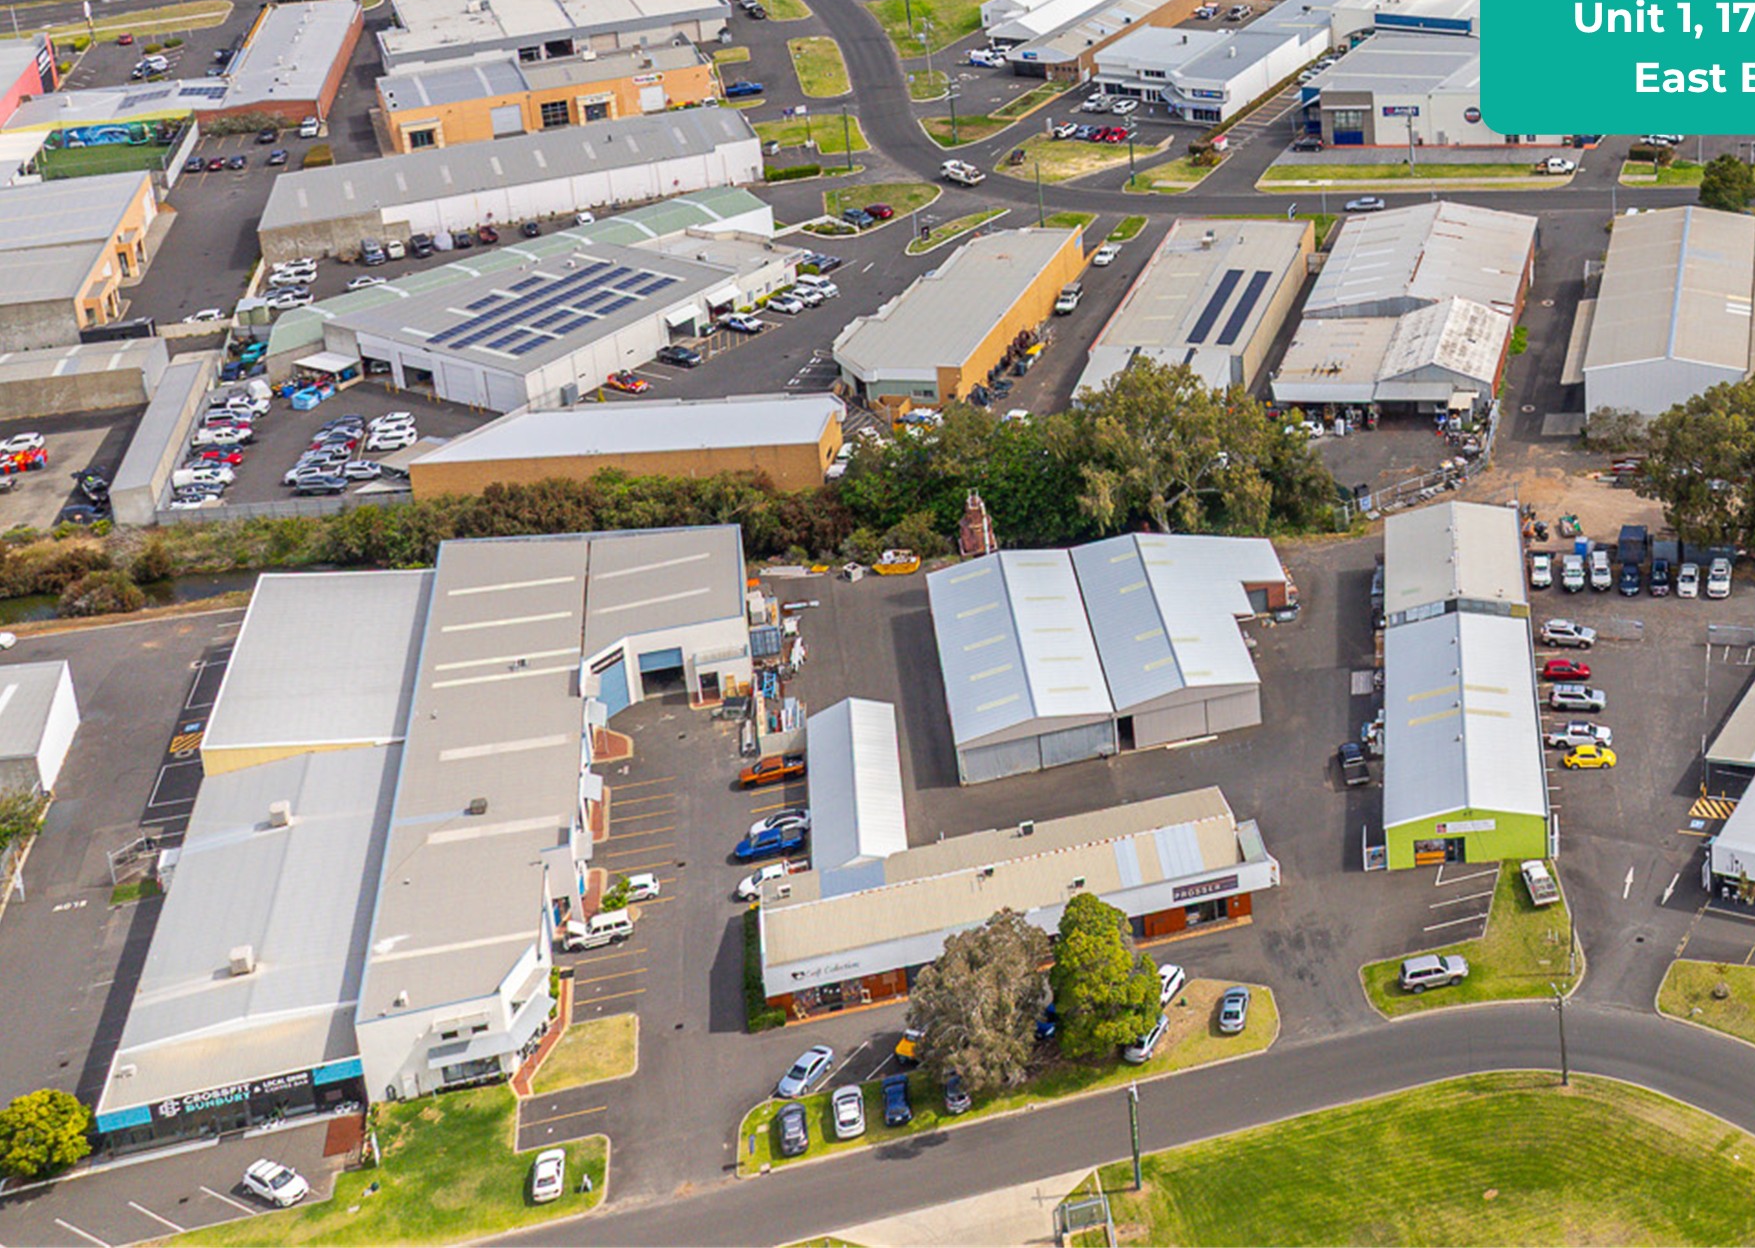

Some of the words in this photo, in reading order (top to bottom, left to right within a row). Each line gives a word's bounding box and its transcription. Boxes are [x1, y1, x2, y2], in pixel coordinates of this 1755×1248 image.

[262, 1077, 285, 1088] LOCAL
[183, 1084, 250, 1104] CROSSFIT
[185, 1091, 250, 1113] BUNBURY
